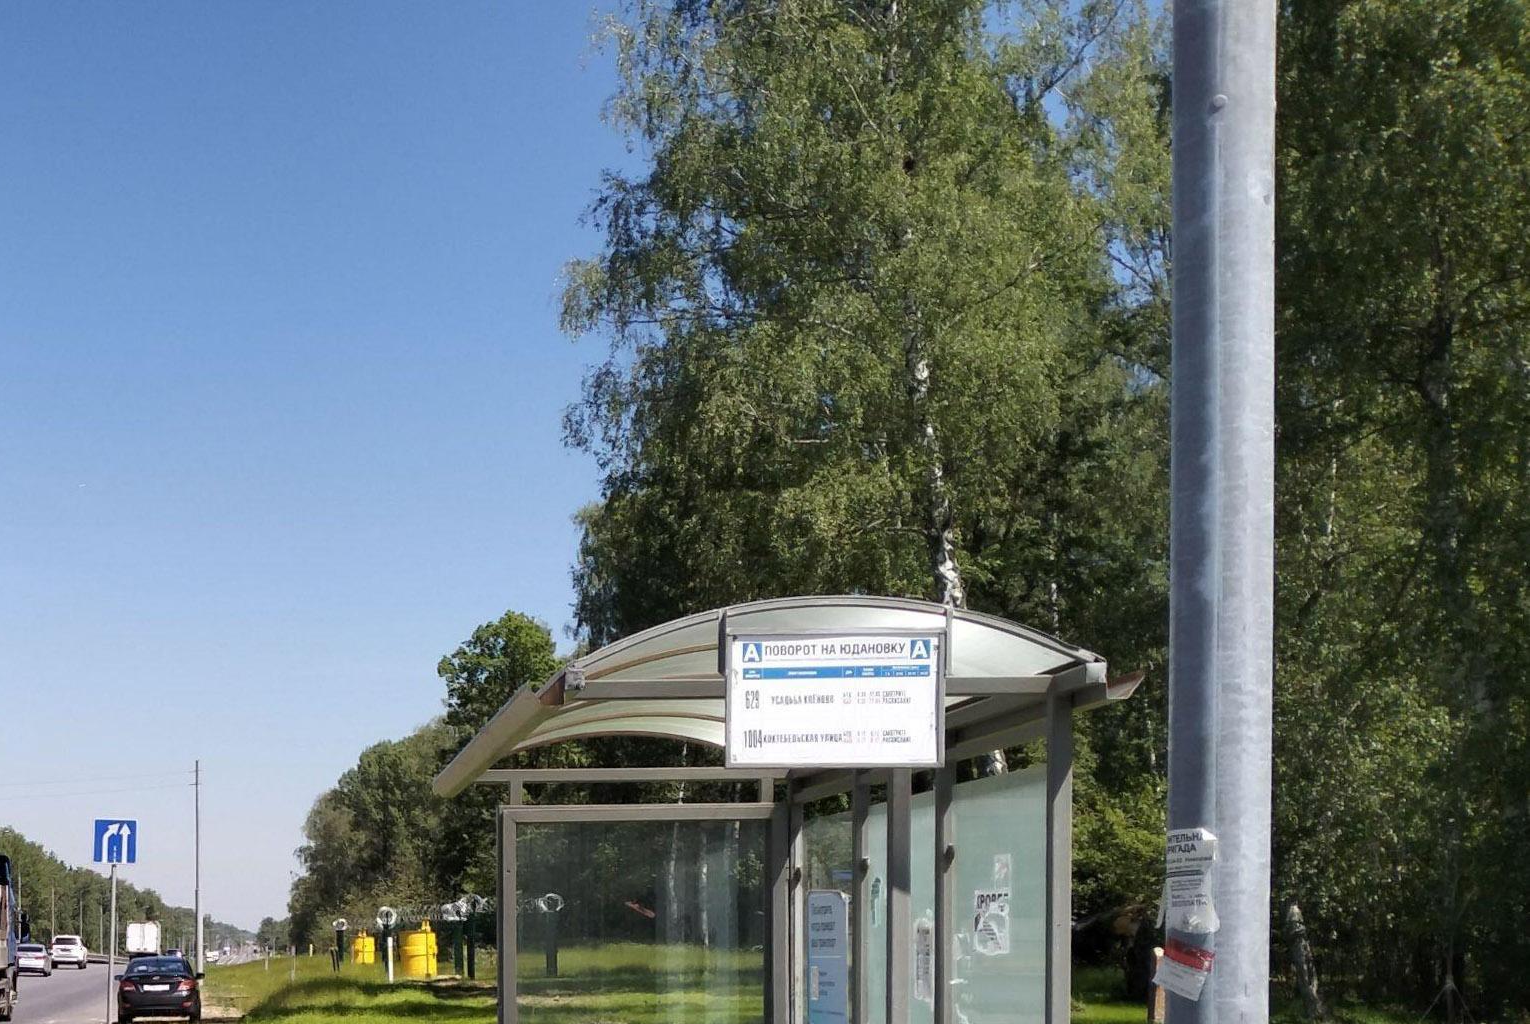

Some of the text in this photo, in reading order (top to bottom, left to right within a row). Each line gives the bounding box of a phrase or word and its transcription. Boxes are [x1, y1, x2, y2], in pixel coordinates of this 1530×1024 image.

[765, 645, 817, 656] ПОВОРОТ
[821, 644, 836, 655] НА
[840, 642, 906, 656] ЮДАНОВКУ
[743, 729, 763, 748] 1004
[820, 733, 843, 743] УЛИЦА
